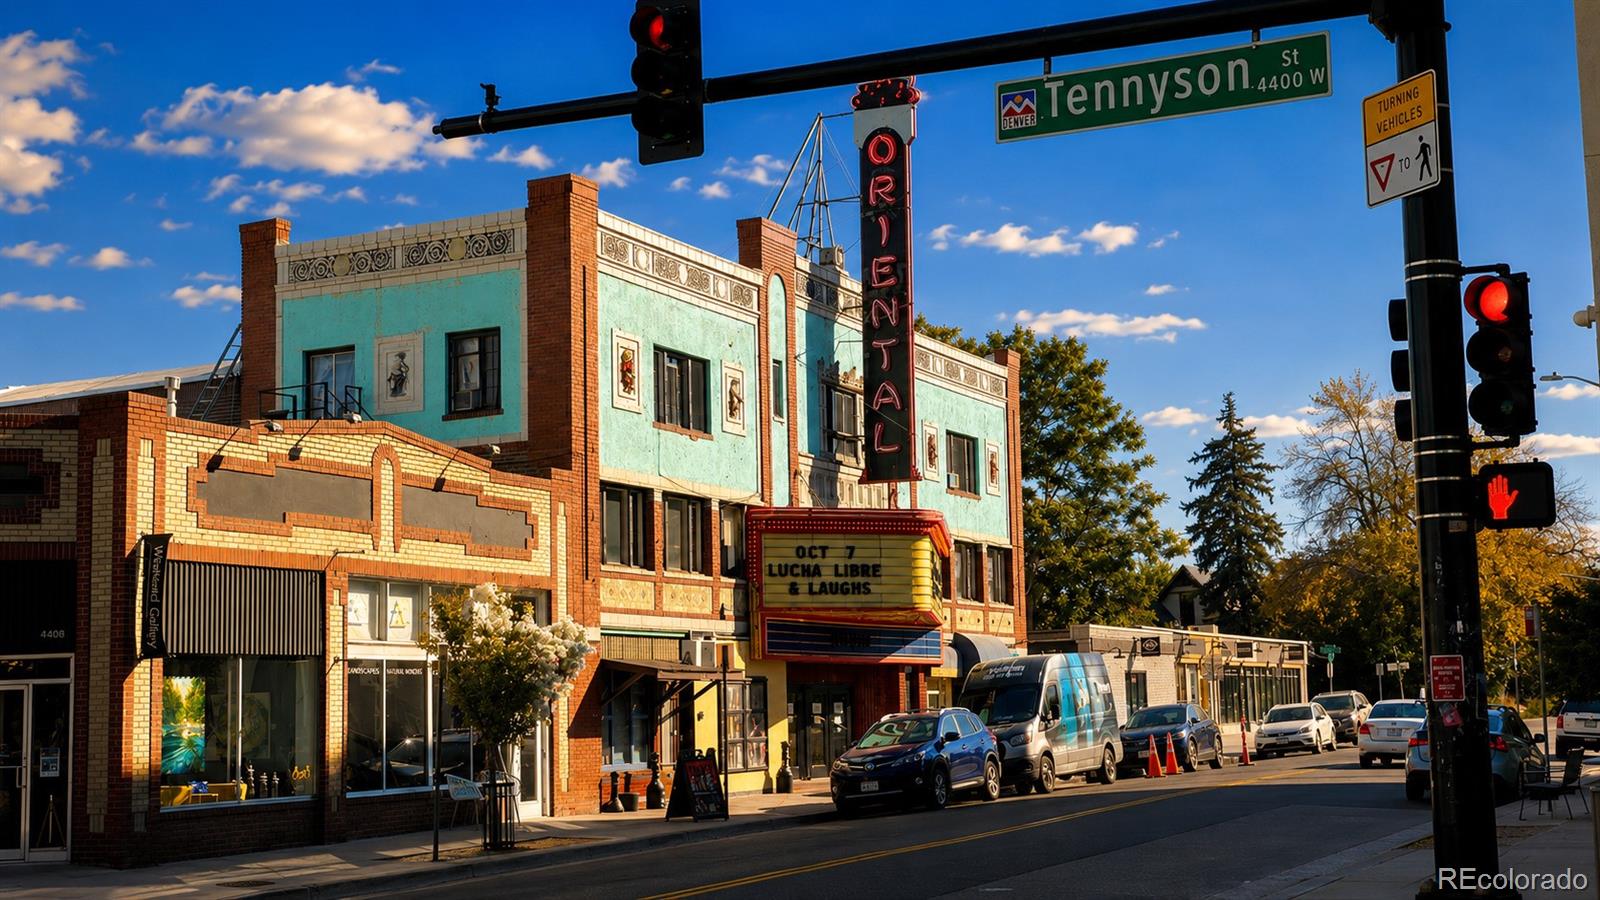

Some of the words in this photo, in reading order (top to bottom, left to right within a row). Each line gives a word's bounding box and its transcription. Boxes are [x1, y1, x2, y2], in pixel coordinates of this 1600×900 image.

[1281, 48, 1299, 67] St
[1044, 58, 1249, 118] Tennyson
[1257, 71, 1303, 92] 4400
[1309, 67, 1325, 84] W
[1378, 86, 1419, 114] TURNING
[1002, 113, 1037, 130] DENVER
[1376, 105, 1423, 134] VEHICLES
[1398, 157, 1411, 173] TO
[868, 133, 902, 453] ORIENTAL
[795, 545, 829, 560] OCT
[845, 545, 856, 560] 7
[768, 563, 822, 578] LUCHA
[834, 563, 882, 578] LIBRE
[788, 581, 799, 596] &
[808, 582, 872, 596] LAUGHS
